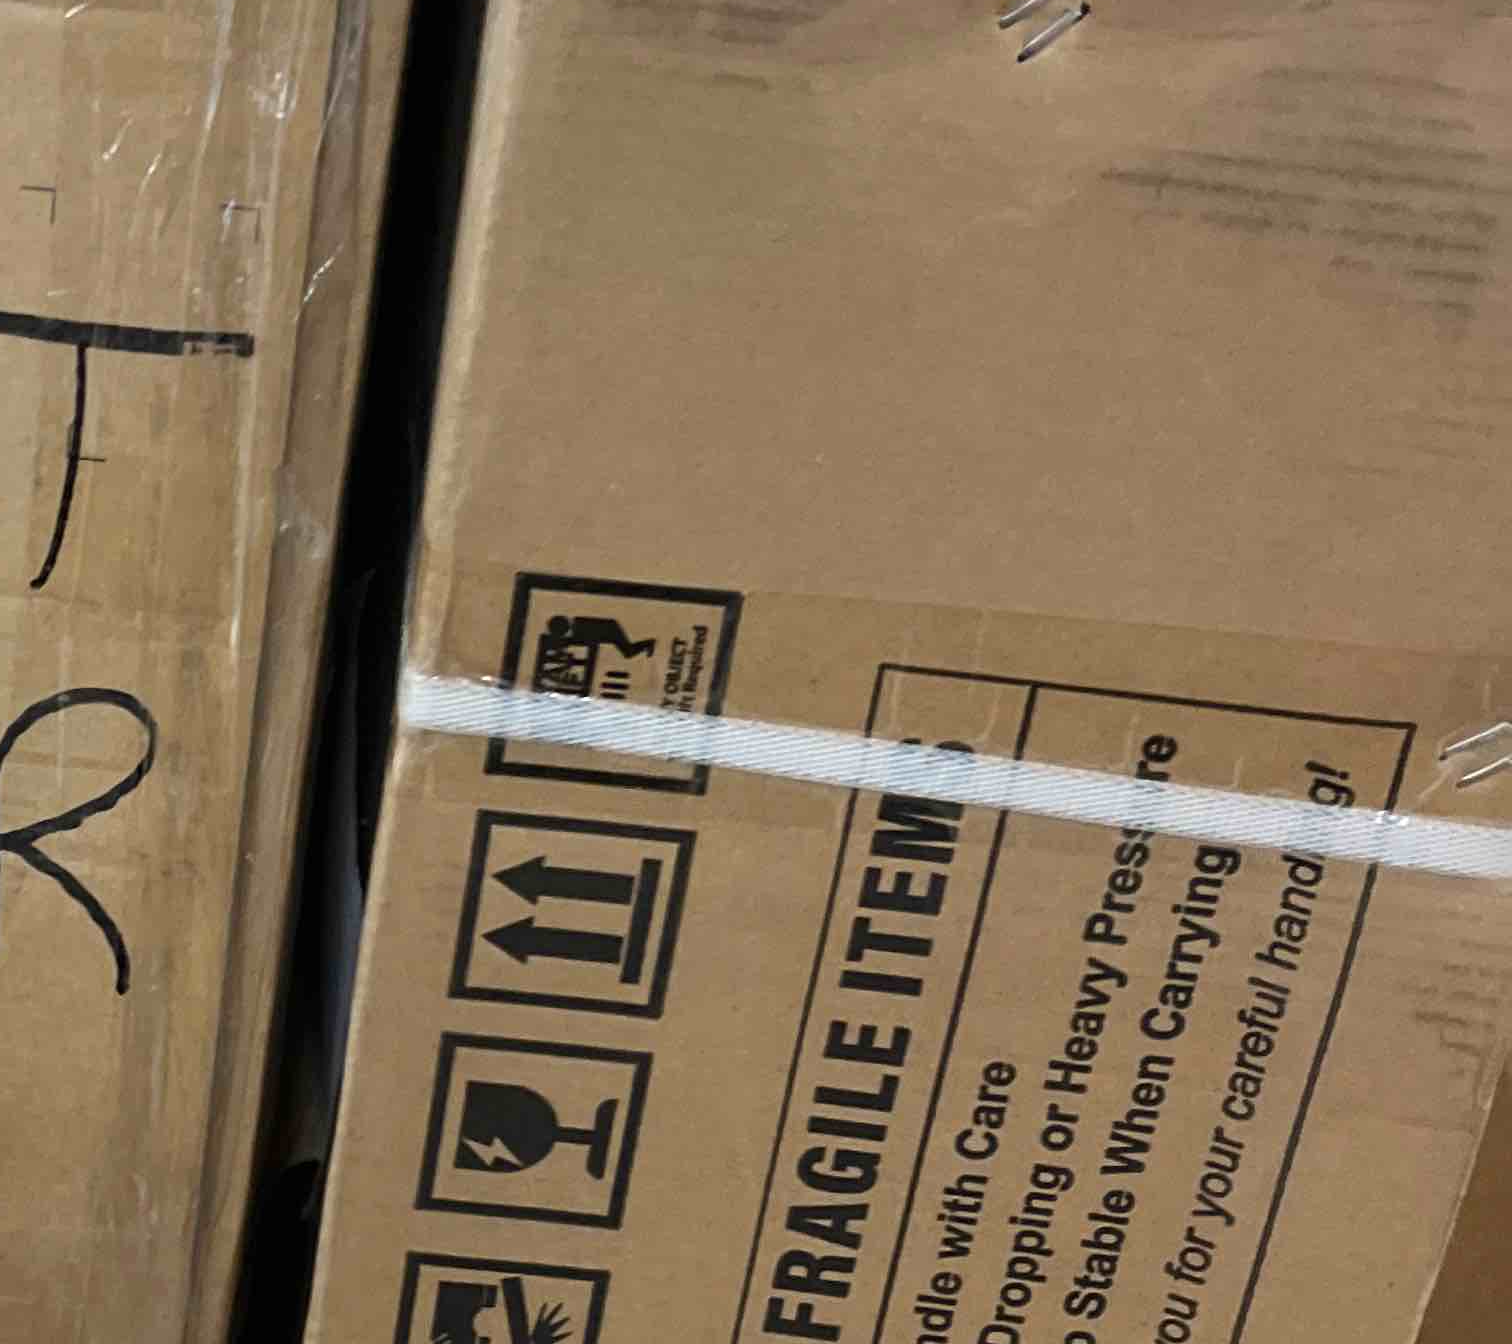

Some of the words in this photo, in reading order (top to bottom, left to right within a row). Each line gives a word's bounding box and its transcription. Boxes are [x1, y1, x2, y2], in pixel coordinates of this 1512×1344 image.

[1254, 759, 1356, 971] handg!
[1140, 844, 1241, 1041] Carrying
[1044, 956, 1128, 1095] Heavy
[1221, 976, 1291, 1122] careful
[954, 1060, 1017, 1160] Care
[1040, 1103, 1080, 1153] or
[1099, 1054, 1175, 1175] When
[762, 1019, 912, 1343] FRAGILE
[937, 1173, 990, 1260] with
[1191, 1125, 1245, 1227] your
[1063, 1188, 1136, 1320] Stable
[1164, 1225, 1216, 1286] for
